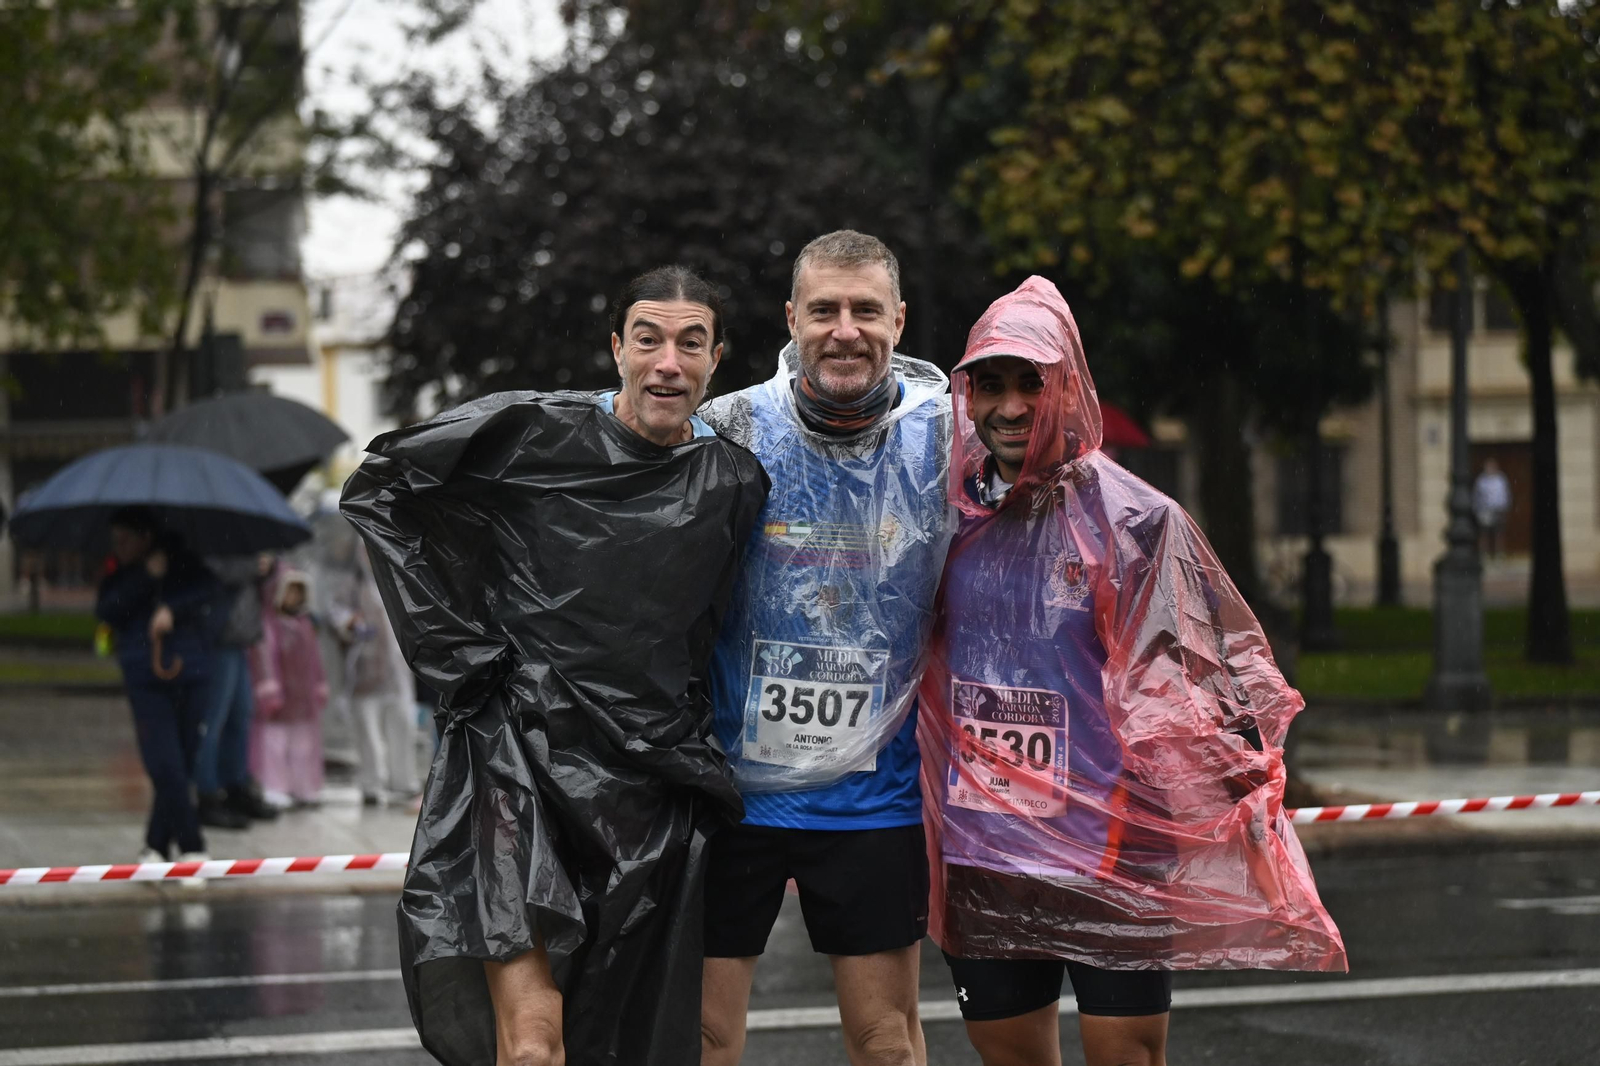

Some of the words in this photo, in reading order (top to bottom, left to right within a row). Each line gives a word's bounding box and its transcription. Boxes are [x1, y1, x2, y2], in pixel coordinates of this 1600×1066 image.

[816, 649, 860, 664] MEDIA
[997, 690, 1040, 704] MEDIA
[762, 684, 869, 727] 3507
[997, 702, 1041, 714] MARATÓN
[991, 711, 1045, 724] CÓRDOBA
[794, 733, 832, 745] ANTONIO
[989, 777, 1010, 787] JUAN
[1013, 798, 1048, 809] IMDECO
